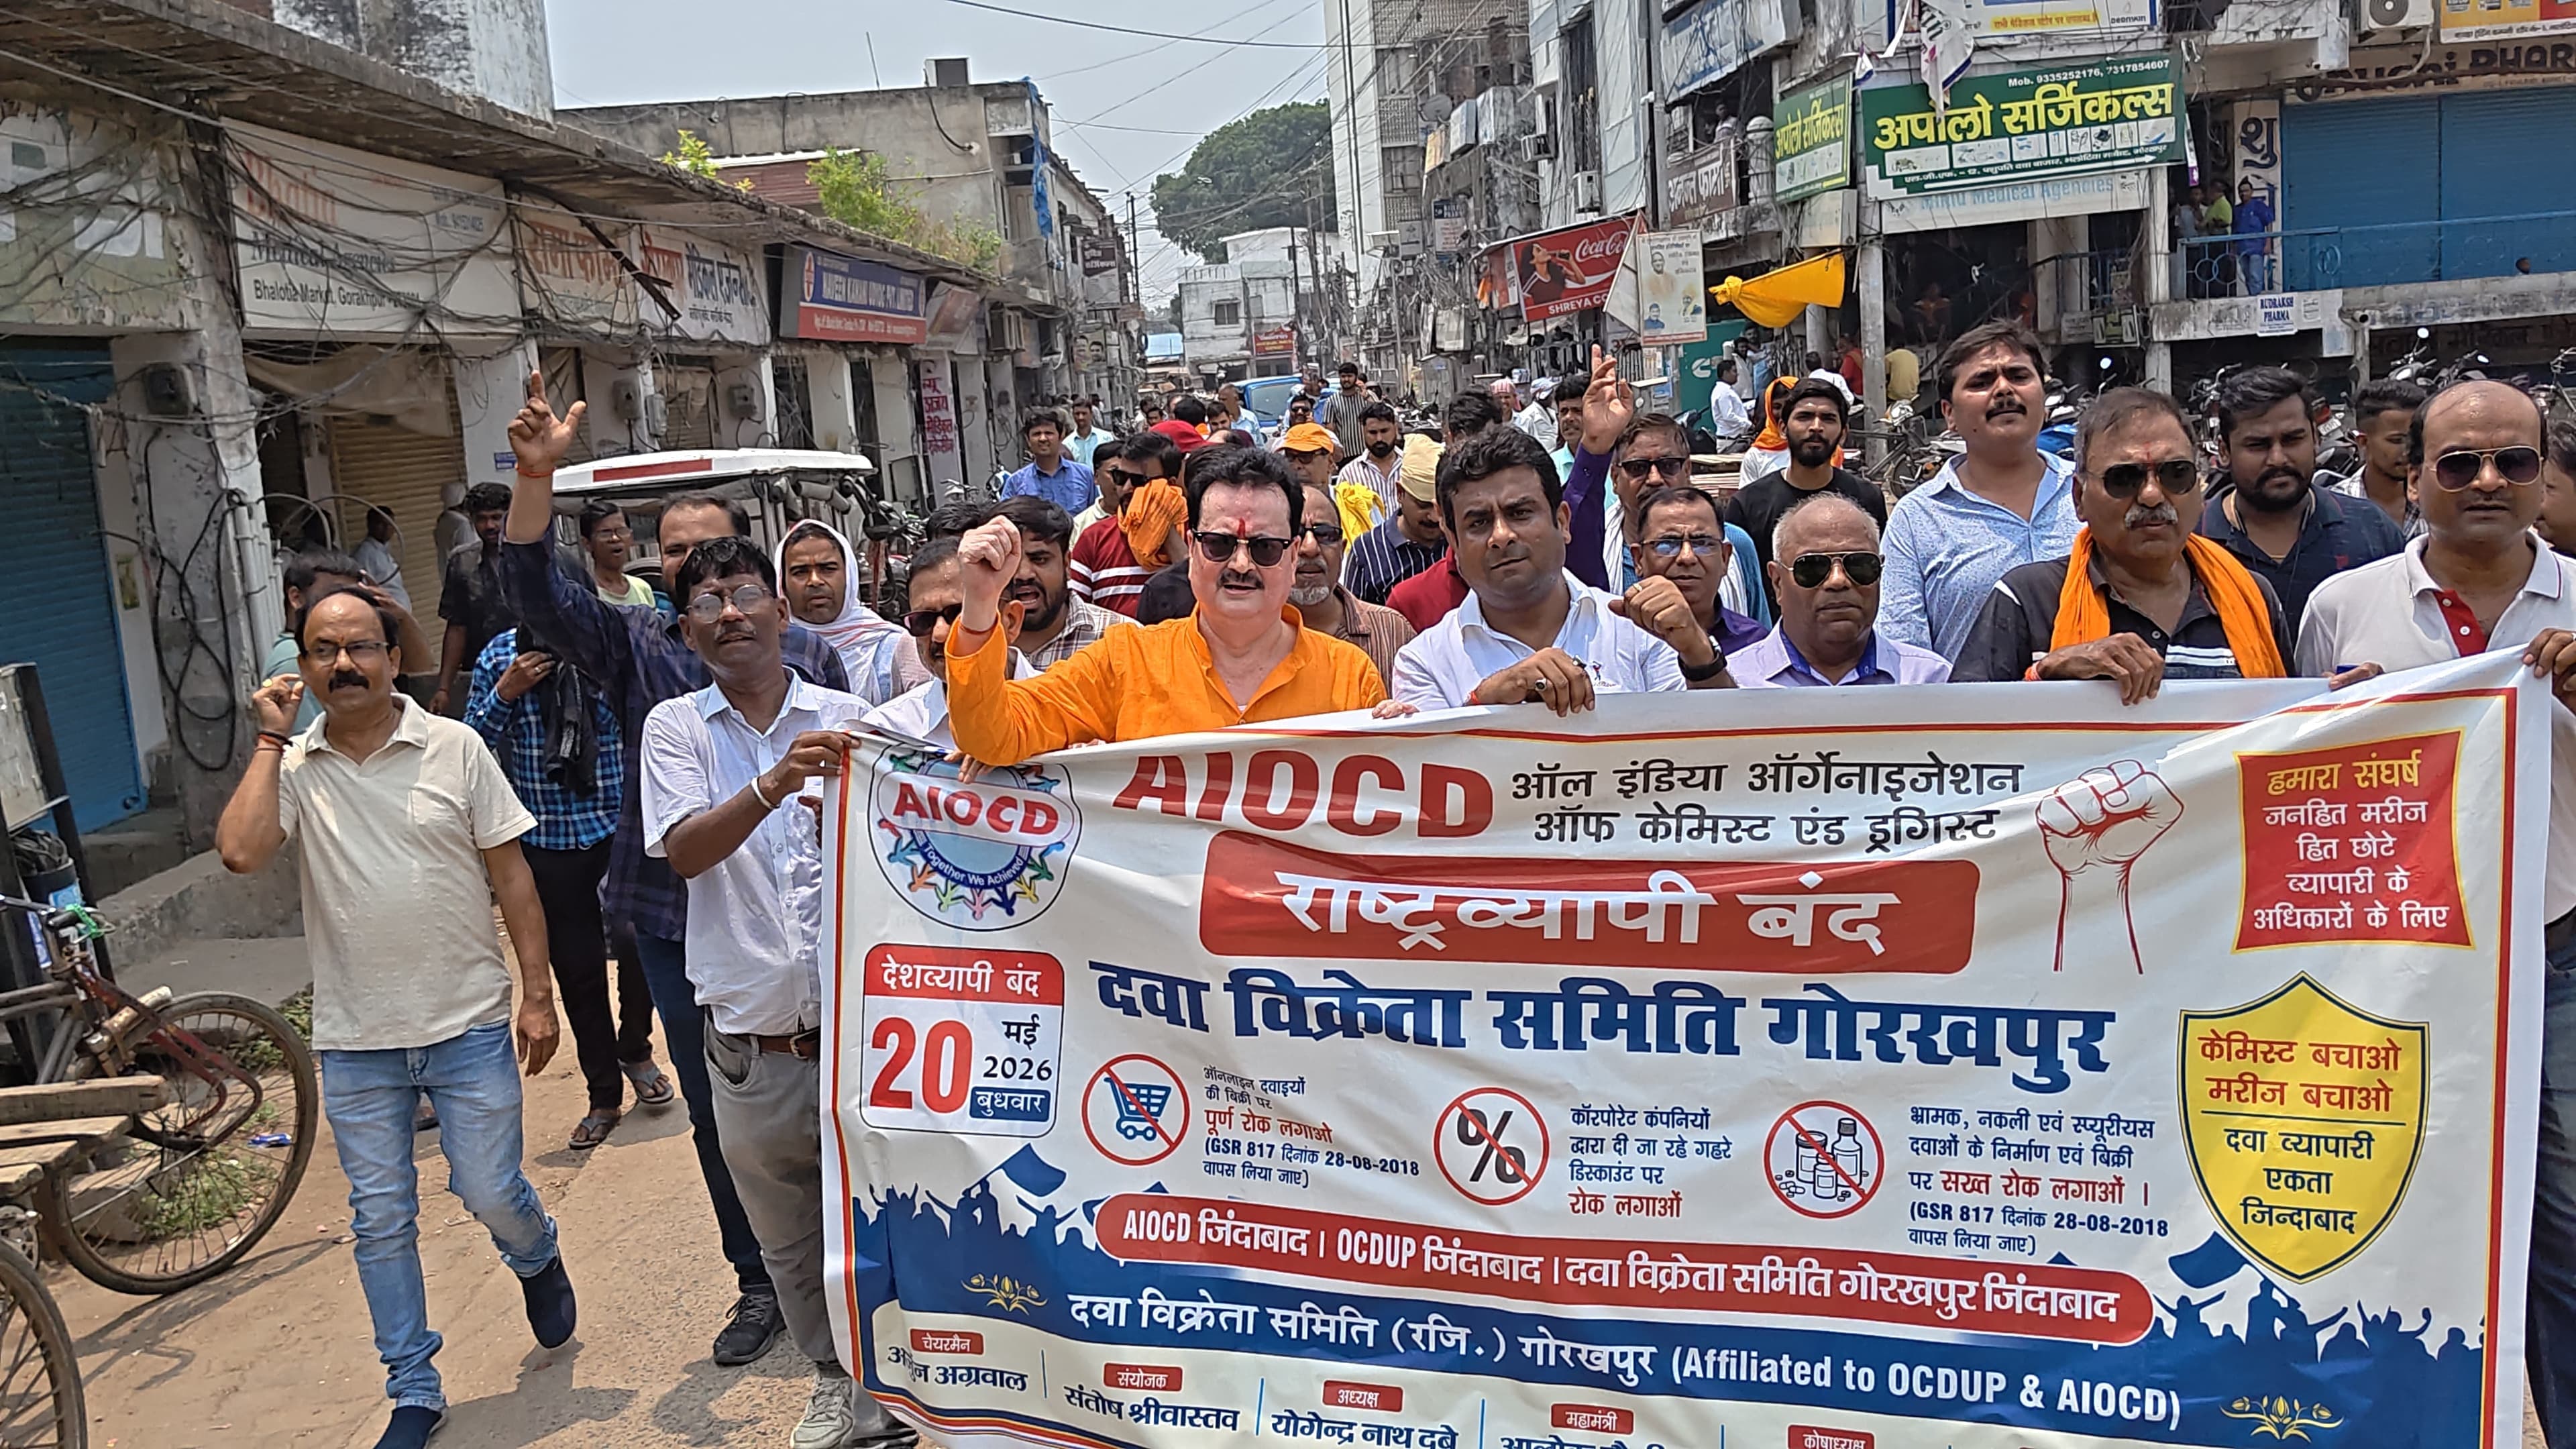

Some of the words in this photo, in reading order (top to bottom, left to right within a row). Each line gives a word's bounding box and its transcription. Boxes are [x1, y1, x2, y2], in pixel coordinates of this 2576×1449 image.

[2008, 76, 2034, 87] Mob.
[2036, 68, 2104, 83] 9335252176,
[2000, 80, 2174, 137] सर्जिकल्स
[1775, 107, 1802, 160] अपोलो
[1802, 97, 1845, 150] सर्जिकल्स
[1973, 184, 2035, 206] Medical
[2040, 177, 2114, 201] Agencies
[1548, 297, 1592, 314] SHREYA
[2260, 297, 2294, 309] RUDRAKSH
[2264, 310, 2290, 322] PHARMA
[1512, 762, 1597, 800] ऑल
[1613, 758, 1728, 800] इंडिया
[1748, 751, 2025, 802] ऑर्गेनाइजेशन
[2267, 763, 2343, 796] हमारा
[2352, 749, 2422, 789] संघर्ष
[893, 782, 1059, 836] AIOCD
[1112, 749, 1494, 838] AIOCD
[1534, 805, 1619, 844] ऑफ
[1635, 801, 1776, 845] केमिस्ट
[1794, 806, 1851, 846] एंड
[1864, 807, 2002, 854] ड्रगिस्ट
[2262, 798, 2348, 827] जनहित
[2357, 796, 2428, 824] मरीज
[2296, 833, 2340, 862] हित
[2349, 830, 2398, 859] छोटे
[924, 842, 966, 883] Together
[967, 874, 985, 886] We
[2286, 866, 2375, 895] व्यापारी
[2384, 864, 2411, 893] के
[1274, 869, 1719, 951] राष्ट्रव्यापी
[1736, 871, 1902, 956] बंद
[2253, 900, 2355, 930] अधिकारों
[2363, 900, 2390, 929] के
[2398, 900, 2451, 928] लिए
[881, 954, 995, 994] देशव्यापी
[1004, 962, 1042, 998] बंद
[1002, 1014, 1040, 1051] मई
[1088, 961, 1211, 1033] दवा
[1224, 968, 1472, 1049] विक्रेता
[1486, 977, 1746, 1055] समिति
[1762, 982, 2116, 1094] गोरखपुर
[869, 1016, 973, 1114] 20
[2197, 1028, 2298, 1065] केमिस्ट
[2308, 1037, 2402, 1072] बचाओ
[983, 1056, 1053, 1081] 2026
[1203, 1065, 1255, 1091] ऑनलाइन
[1259, 1076, 1306, 1097] दवाइयों
[975, 1091, 1046, 1117] बुधवार
[1204, 1085, 1220, 1102] की
[1225, 1087, 1252, 1106] बिक्री
[1255, 1095, 1273, 1110] पर
[2204, 1071, 2289, 1106] मरीज
[2299, 1077, 2394, 1113] बचाओ
[1204, 1106, 1234, 1136] पूर्ण
[1240, 1108, 1271, 1134] रोक
[1277, 1119, 1334, 1144] लगाओ
[1570, 1104, 1638, 1127] कॉरपोरेट
[1644, 1106, 1711, 1130] कंपनियों
[1910, 1106, 1969, 1130] भ्रामक,
[1977, 1108, 2031, 1132] नकली
[2037, 1110, 2065, 1134] एवं
[2071, 1113, 2155, 1143] स्प्यूरीयस
[1205, 1137, 1241, 1157] (GSR
[1247, 1140, 1275, 1159] 817
[1281, 1143, 1320, 1165] दिनांक
[1325, 1150, 1419, 1177] 28-08-2018
[1570, 1136, 1605, 1155] द्वारा
[1612, 1132, 1629, 1156] दी
[1635, 1138, 1658, 1156] जा
[1664, 1134, 1688, 1159] रहे
[1693, 1136, 1733, 1160] गहरे
[1909, 1133, 1960, 1157] दवाओं
[1967, 1135, 1985, 1159] के
[1991, 1137, 2051, 1164] निर्माण
[2057, 1142, 2084, 1166] एवं
[2090, 1145, 2134, 1169] बिक्री
[2222, 1127, 2268, 1154] दवा
[2278, 1130, 2375, 1161] व्यापारी
[1202, 1160, 1236, 1178] वापस
[1241, 1161, 1272, 1181] लिया
[1277, 1167, 1309, 1189] जाए)
[1568, 1159, 1635, 1183] डिस्काउंट
[1641, 1167, 1664, 1185] पर
[1909, 1171, 1933, 1191] पर
[1939, 1170, 1992, 1195] सख्त
[2000, 1168, 2041, 1199] रोक
[2049, 1174, 2125, 1205] लगाओं
[2262, 1166, 2334, 1195] एकता
[1568, 1186, 1607, 1215] रोक
[1613, 1190, 1683, 1218] लगाओं
[1909, 1201, 1953, 1222] (GSR
[1960, 1205, 1994, 1224] 817
[2002, 1206, 2047, 1228] दिनांक
[2053, 1212, 2169, 1238] 28-08-2018
[2239, 1195, 2359, 1235] जिन्दाबाद
[1908, 1228, 1947, 1246] वापस
[1953, 1228, 1991, 1250] लिया
[1996, 1234, 2037, 1256] जाए)
[1122, 1208, 1191, 1244] AIOCD
[1197, 1210, 1311, 1258] जिंदाबाद
[1336, 1231, 1417, 1270] OCDUP
[1421, 1235, 1545, 1285] जिंदाबाद
[1565, 1256, 1621, 1291] दवा
[1626, 1253, 1727, 1295] विक्रेता
[1732, 1255, 1833, 1299] समिति
[1838, 1258, 1980, 1319] गोरखपुर
[1983, 1271, 2119, 1325] जिंदाबाद
[922, 1335, 971, 1354] चेयरमैन
[1068, 1293, 1132, 1328] दवा
[1138, 1287, 1260, 1335] विक्रेता
[1265, 1300, 1380, 1350] समिति
[1517, 1326, 1658, 1382] गोरखपुर
[1670, 1346, 1833, 1391] (Affiliated
[1843, 1358, 1876, 1394] to
[1888, 1363, 2007, 1405] OCDUP
[2019, 1377, 2045, 1409] &
[2056, 1380, 2183, 1432] AIOCD)
[934, 1364, 1028, 1392] अग्रवाल
[1118, 1368, 1169, 1390] संयोजक
[1063, 1384, 1125, 1421] संतोष
[1128, 1397, 1240, 1432] श्रीवास्तव
[1337, 1387, 1381, 1409] अध्यक्ष
[1271, 1409, 1358, 1446] योगेन्द्र
[1361, 1424, 1413, 1449] नाथ
[1565, 1409, 1618, 1432] महामंत्री
